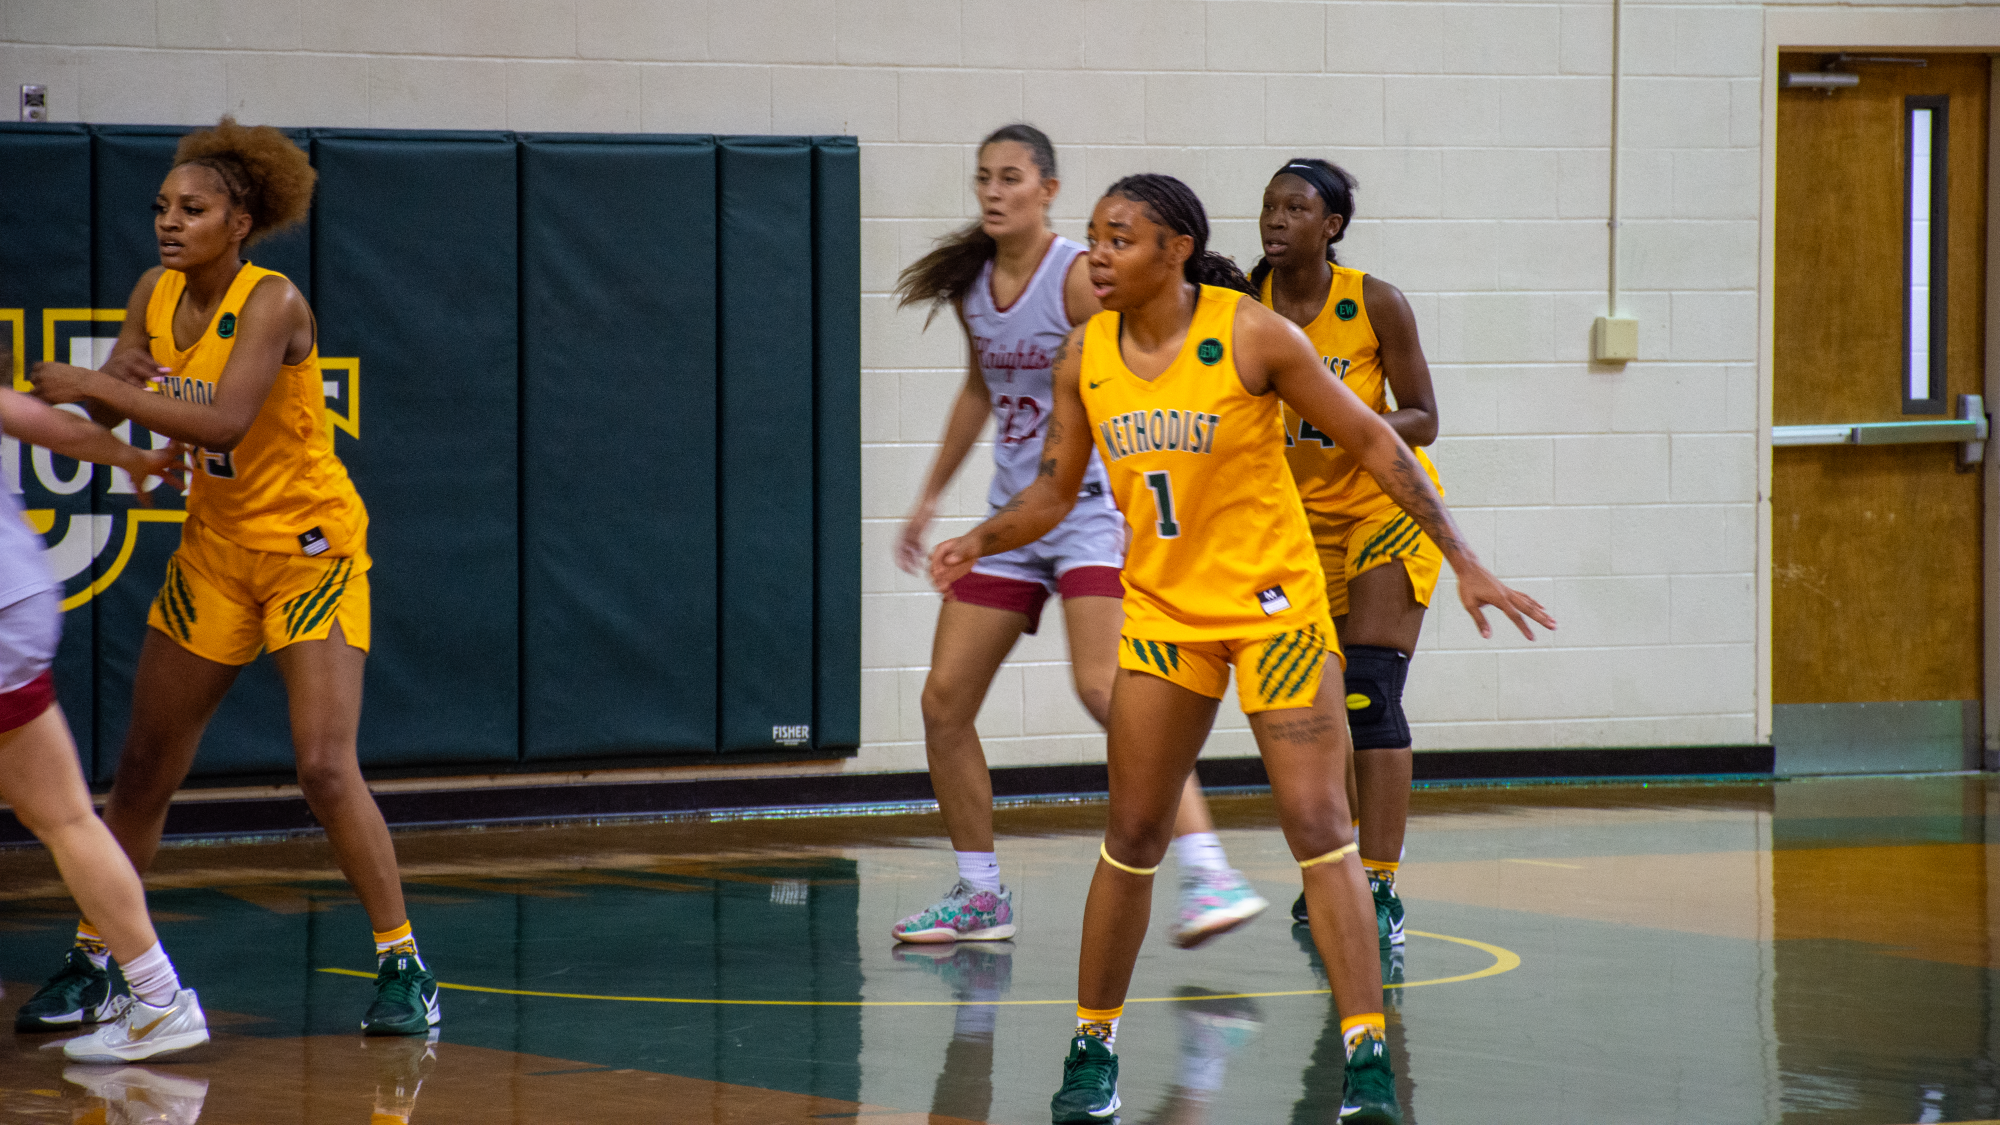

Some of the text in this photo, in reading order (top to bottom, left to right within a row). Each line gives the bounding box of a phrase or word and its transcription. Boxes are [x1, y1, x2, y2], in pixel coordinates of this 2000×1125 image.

[1338, 303, 1355, 316] EW
[973, 335, 1054, 383] Knights
[996, 393, 1042, 447] 22
[1098, 408, 1222, 462] METHODIST
[1144, 470, 1181, 539] 1
[1263, 588, 1278, 601] M
[772, 724, 810, 740] FISHER
